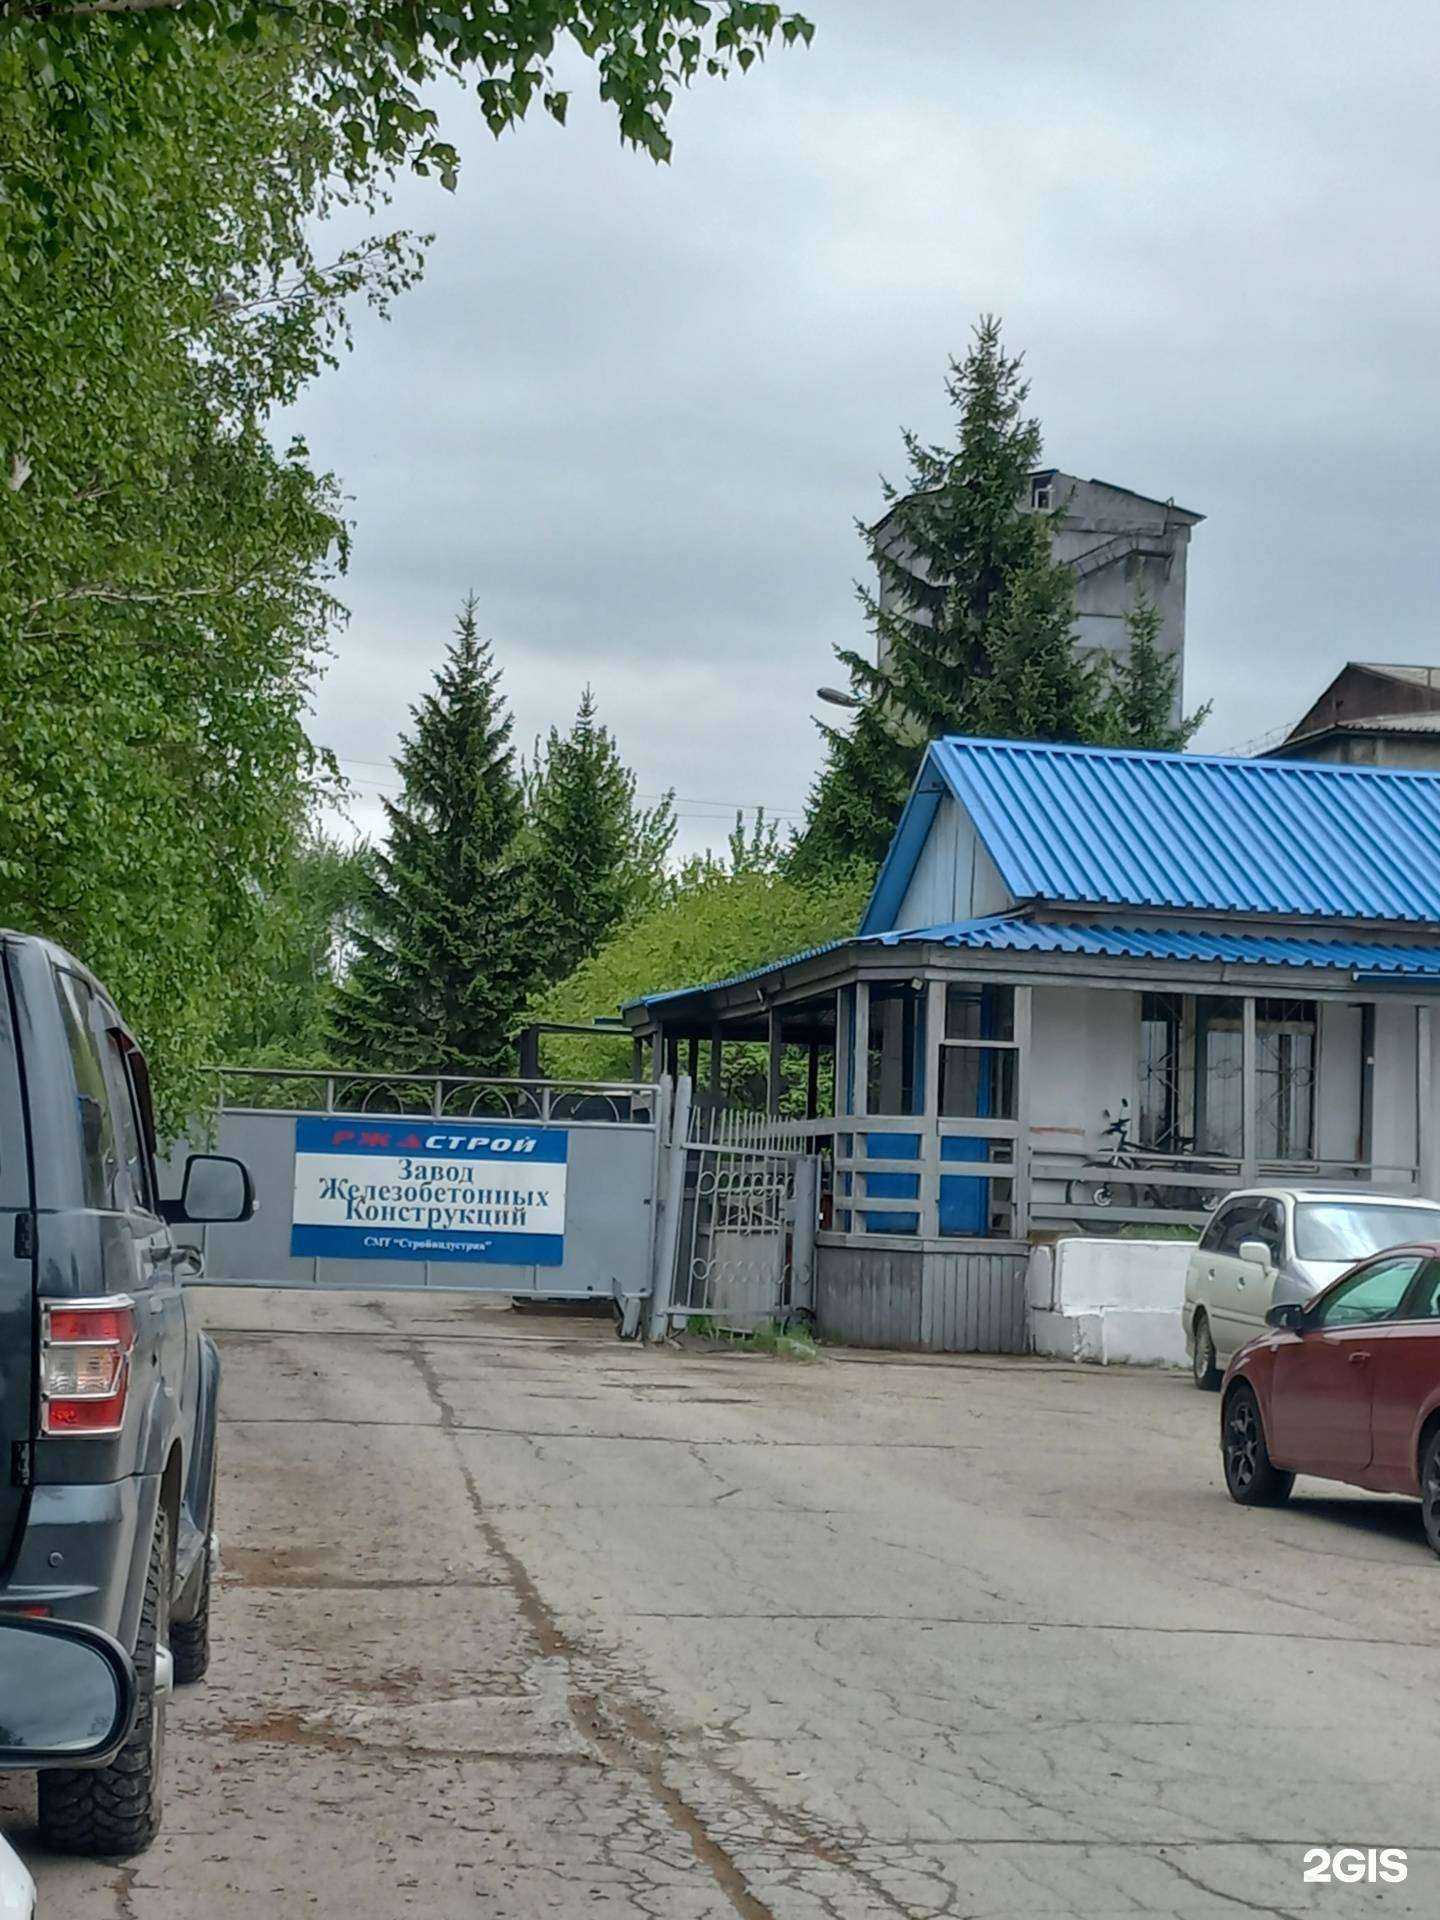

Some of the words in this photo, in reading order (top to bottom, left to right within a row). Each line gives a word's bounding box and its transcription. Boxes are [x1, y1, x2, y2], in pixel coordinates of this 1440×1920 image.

[398, 1159, 474, 1183] Завод
[319, 1177, 550, 1207] Железобетонных
[346, 1199, 527, 1230] Конструкций
[363, 1236, 391, 1248] СМТ
